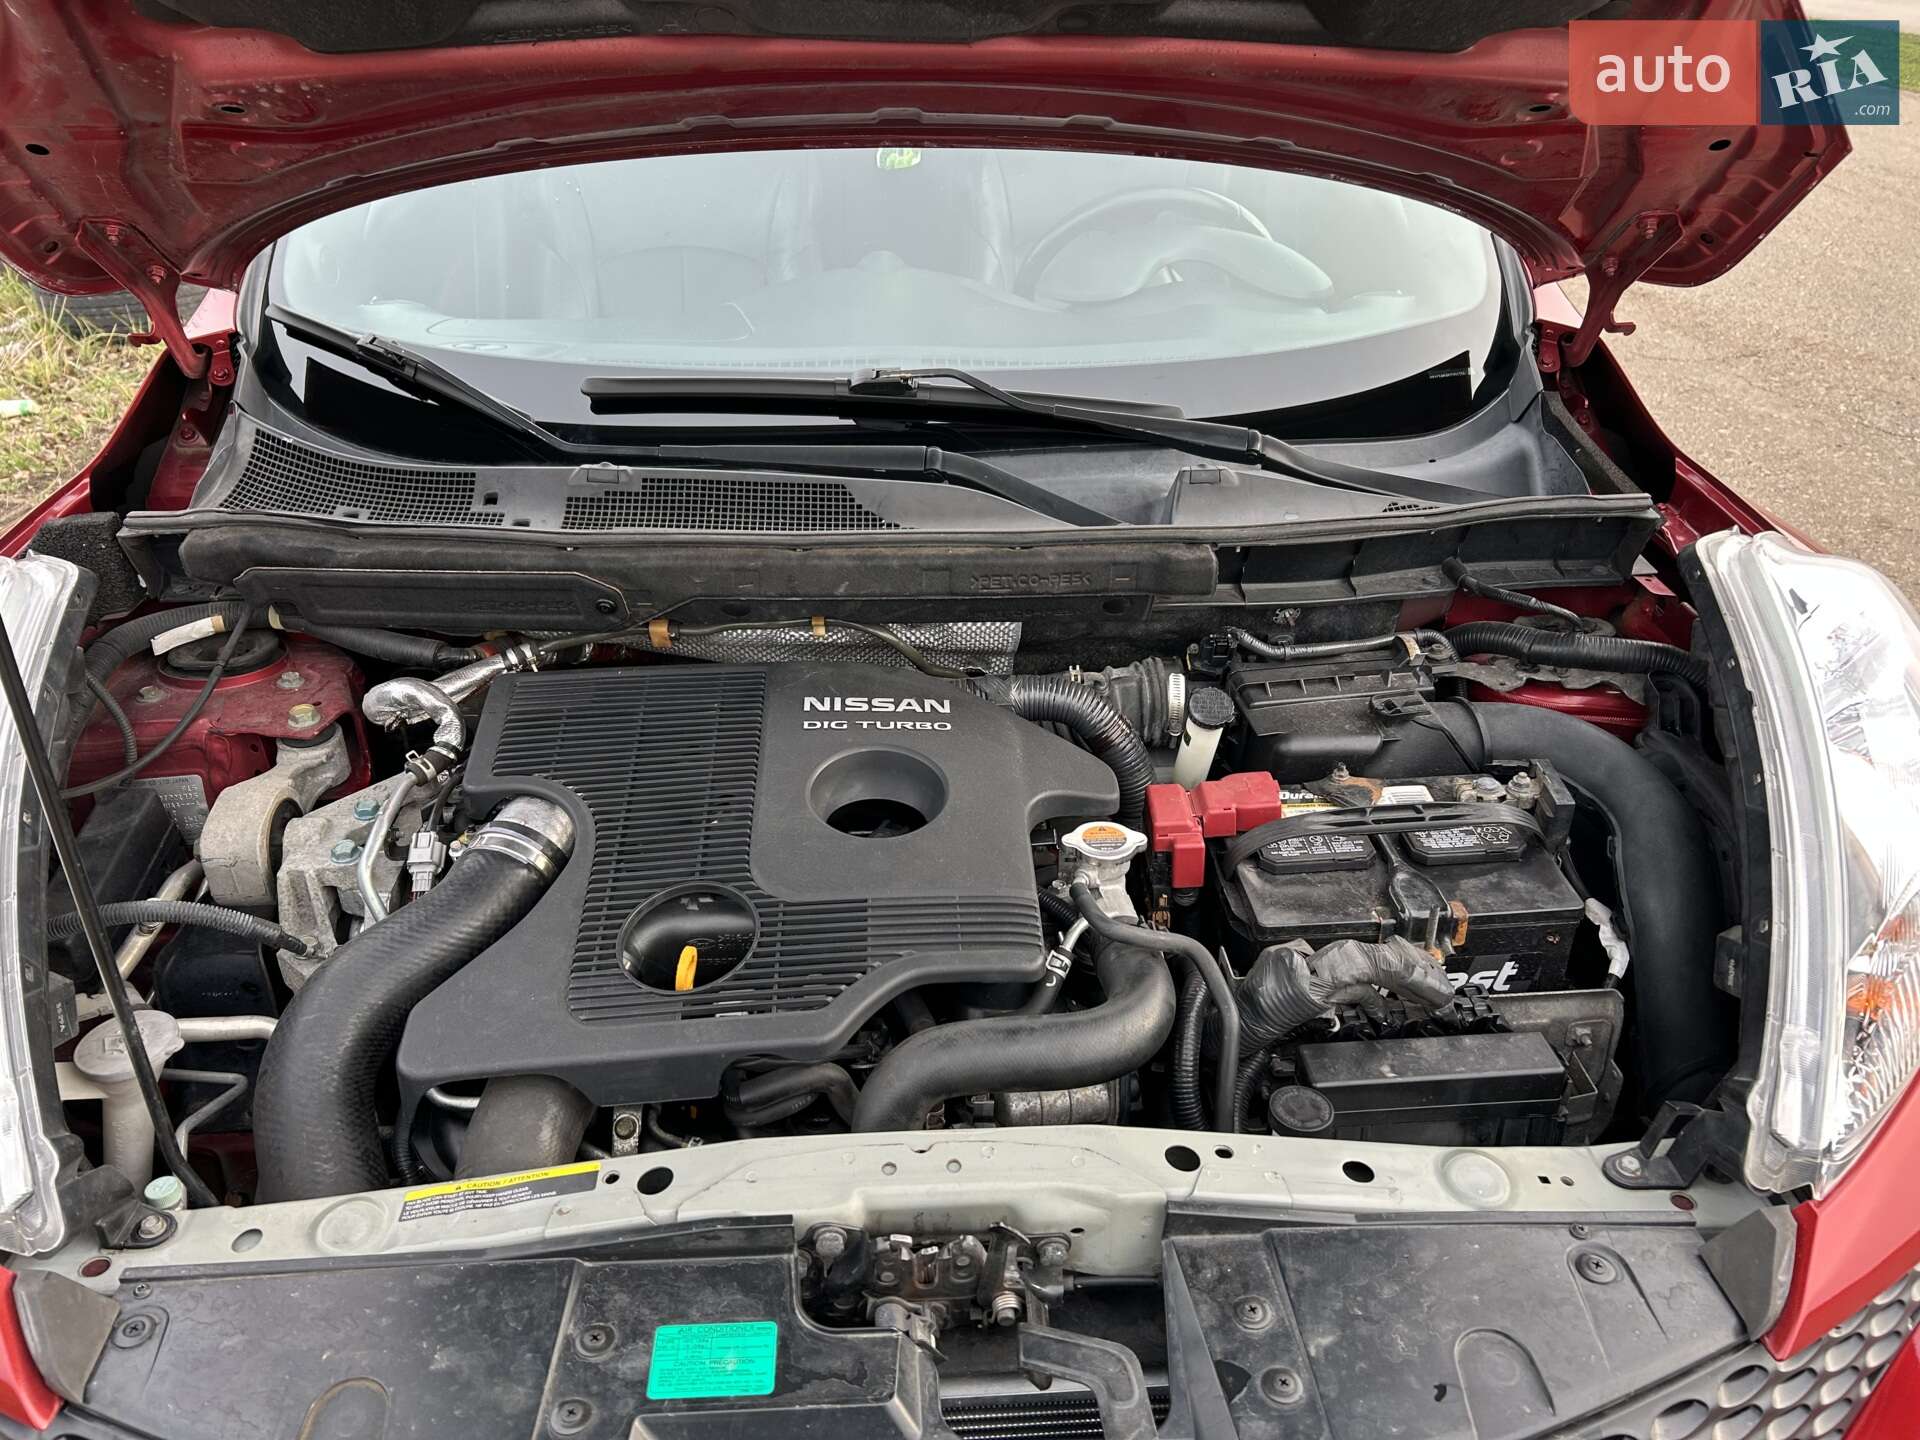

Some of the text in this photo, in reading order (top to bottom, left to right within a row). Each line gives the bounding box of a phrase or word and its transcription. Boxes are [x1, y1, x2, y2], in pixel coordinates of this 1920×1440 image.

[803, 696, 951, 713] NISSAN
[803, 720, 952, 731] DIG TURBO
[1442, 961, 1518, 992] ast
